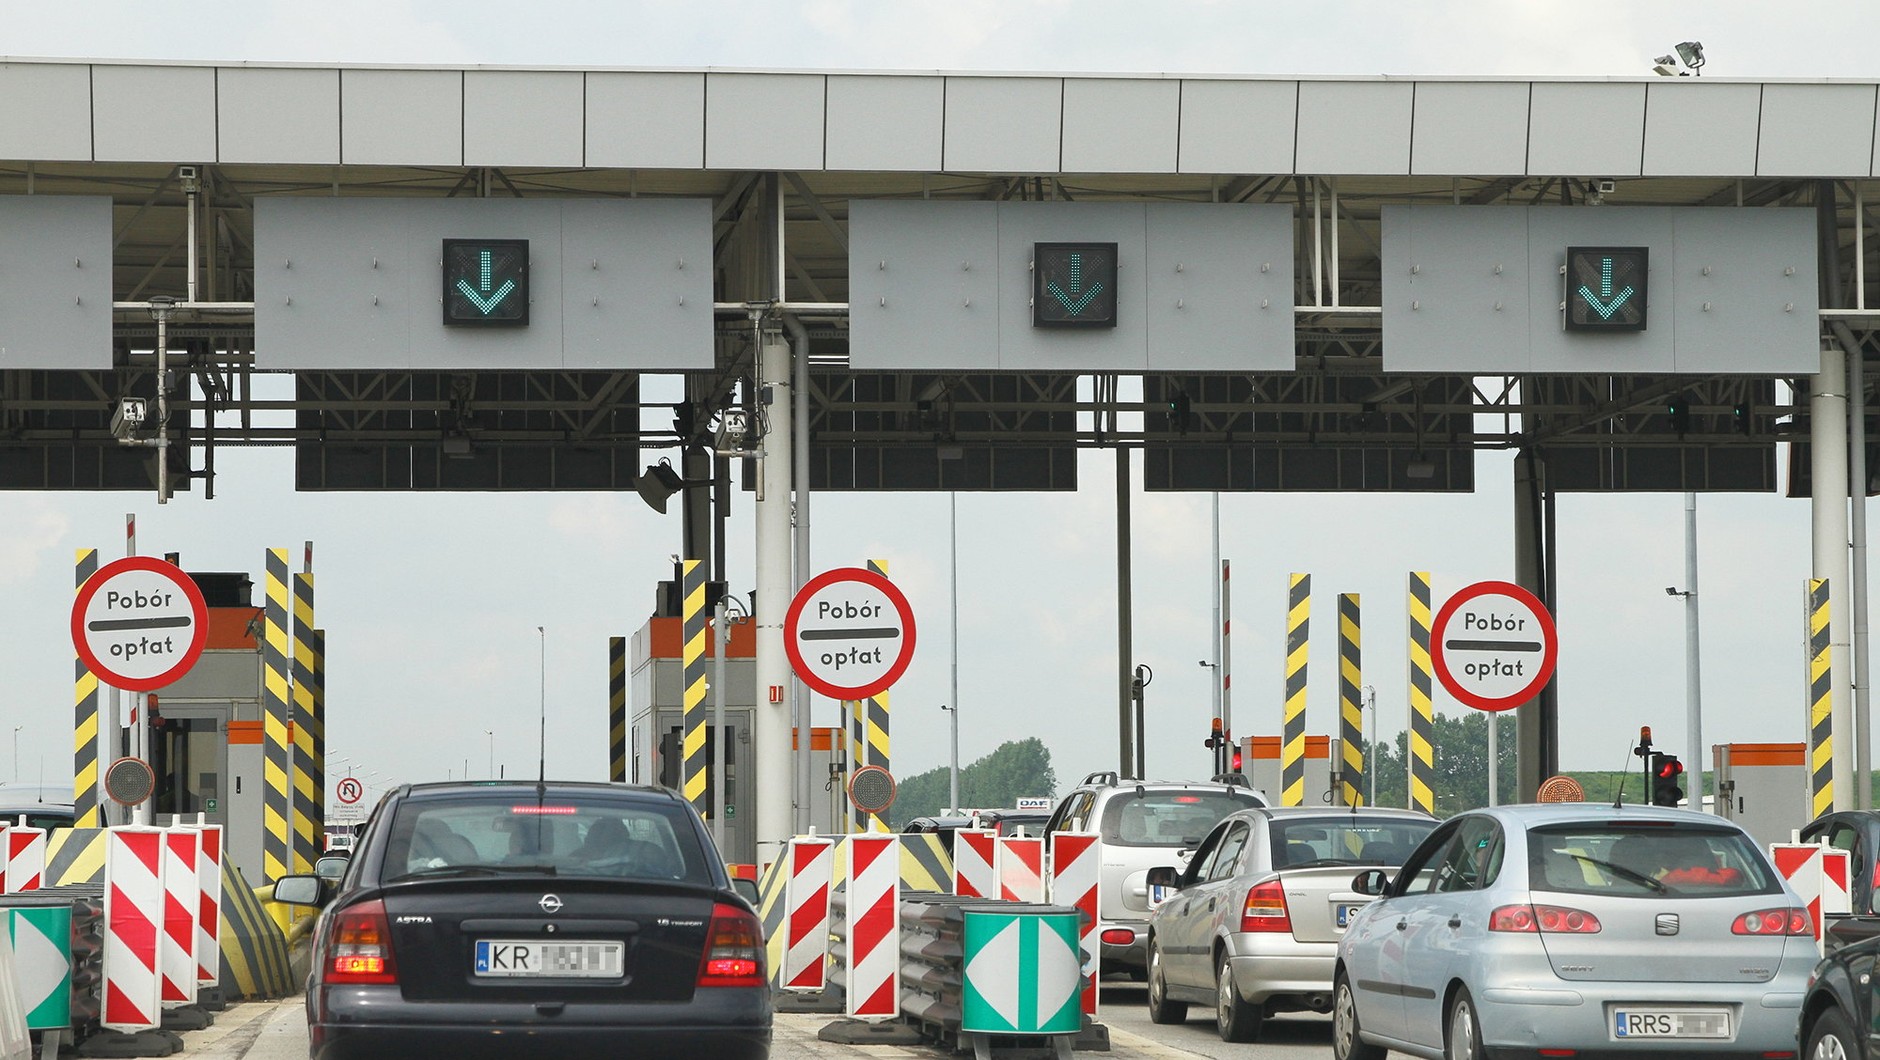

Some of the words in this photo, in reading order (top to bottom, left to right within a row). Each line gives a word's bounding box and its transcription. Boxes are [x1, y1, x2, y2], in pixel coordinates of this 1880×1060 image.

[107, 589, 172, 610] Pobór
[818, 600, 881, 620] Pobór
[1465, 612, 1525, 632] Pobór
[110, 636, 173, 661] opłat
[820, 647, 882, 671] opłat
[1464, 658, 1523, 681] opłat
[396, 916, 433, 924] ASTRA
[478, 959, 488, 968] PL
[493, 945, 530, 970] KR
[1629, 1014, 1672, 1034] RRS
